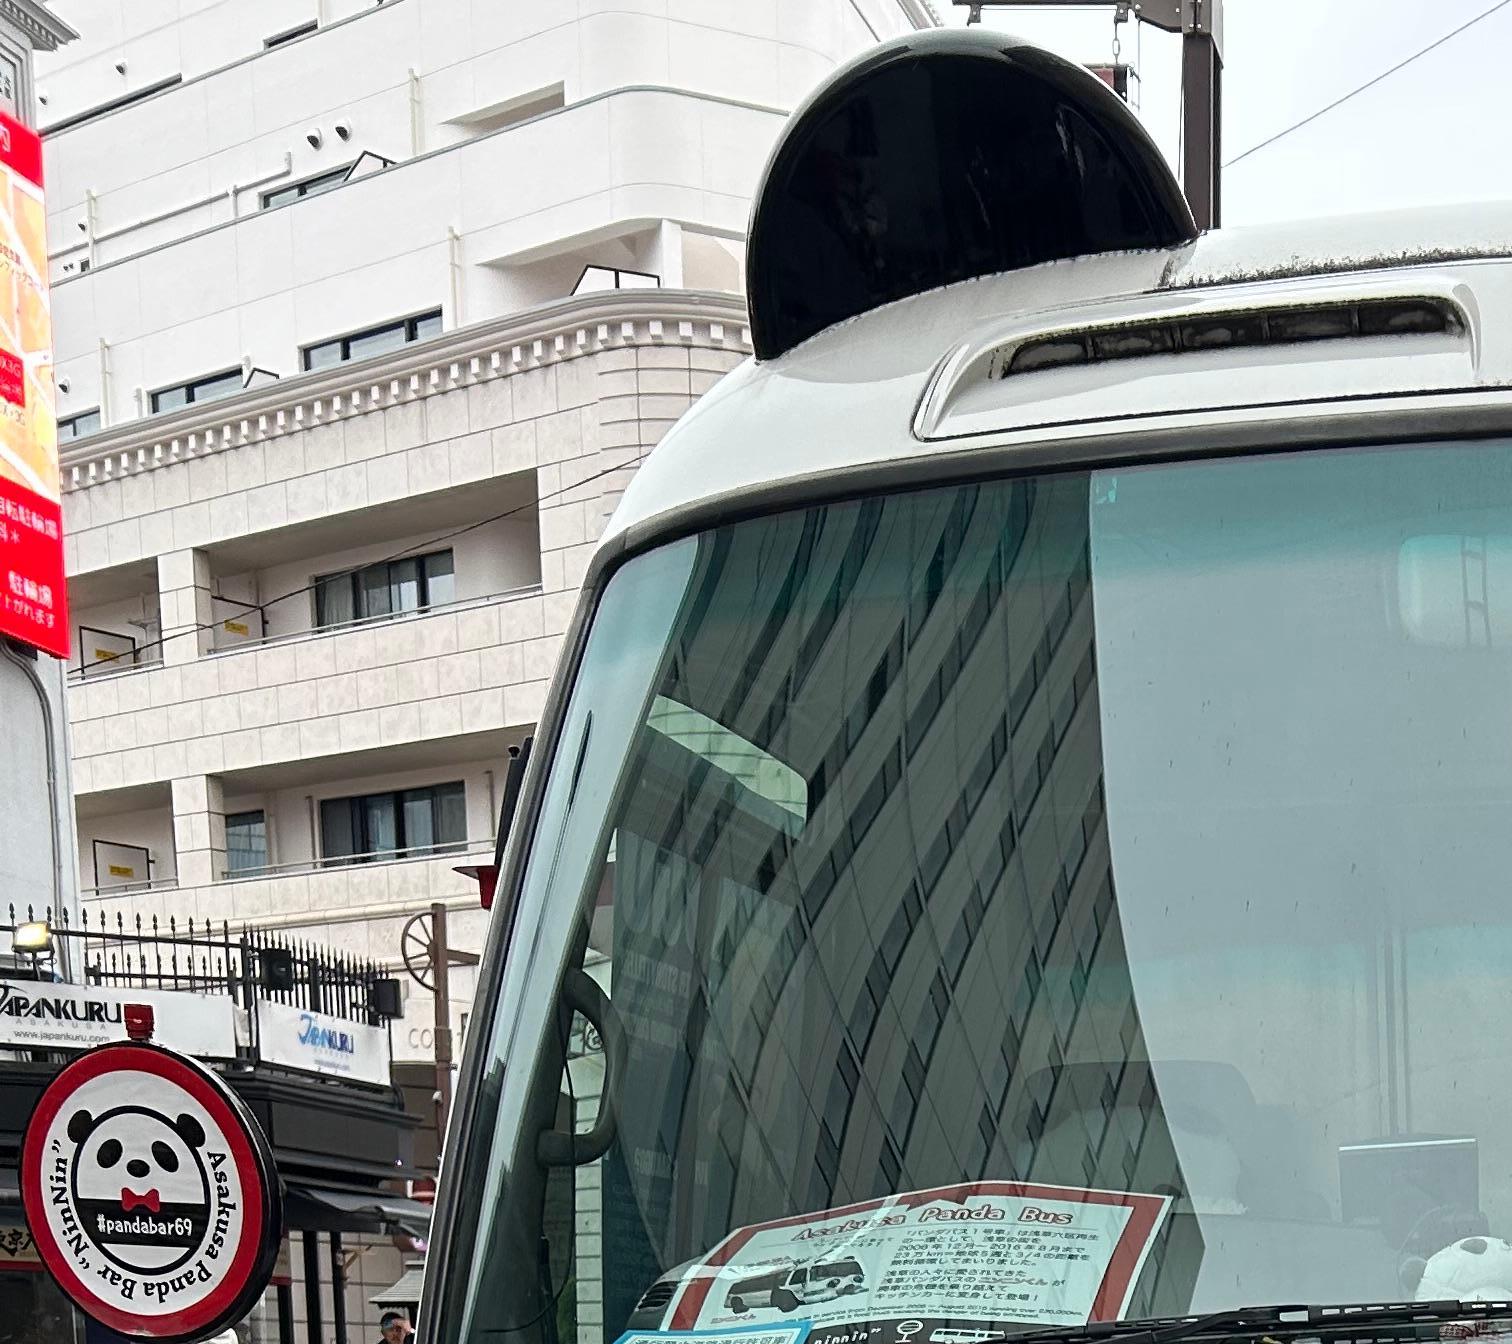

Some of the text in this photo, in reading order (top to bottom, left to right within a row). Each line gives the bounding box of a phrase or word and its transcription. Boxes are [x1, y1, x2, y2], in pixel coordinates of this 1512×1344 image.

[97, 1213, 193, 1236] #pandabar69
[918, 1203, 1006, 1223] Panda
[1018, 1206, 1074, 1225] Bus
[97, 1150, 237, 1304] Asakusa Panda Bar
